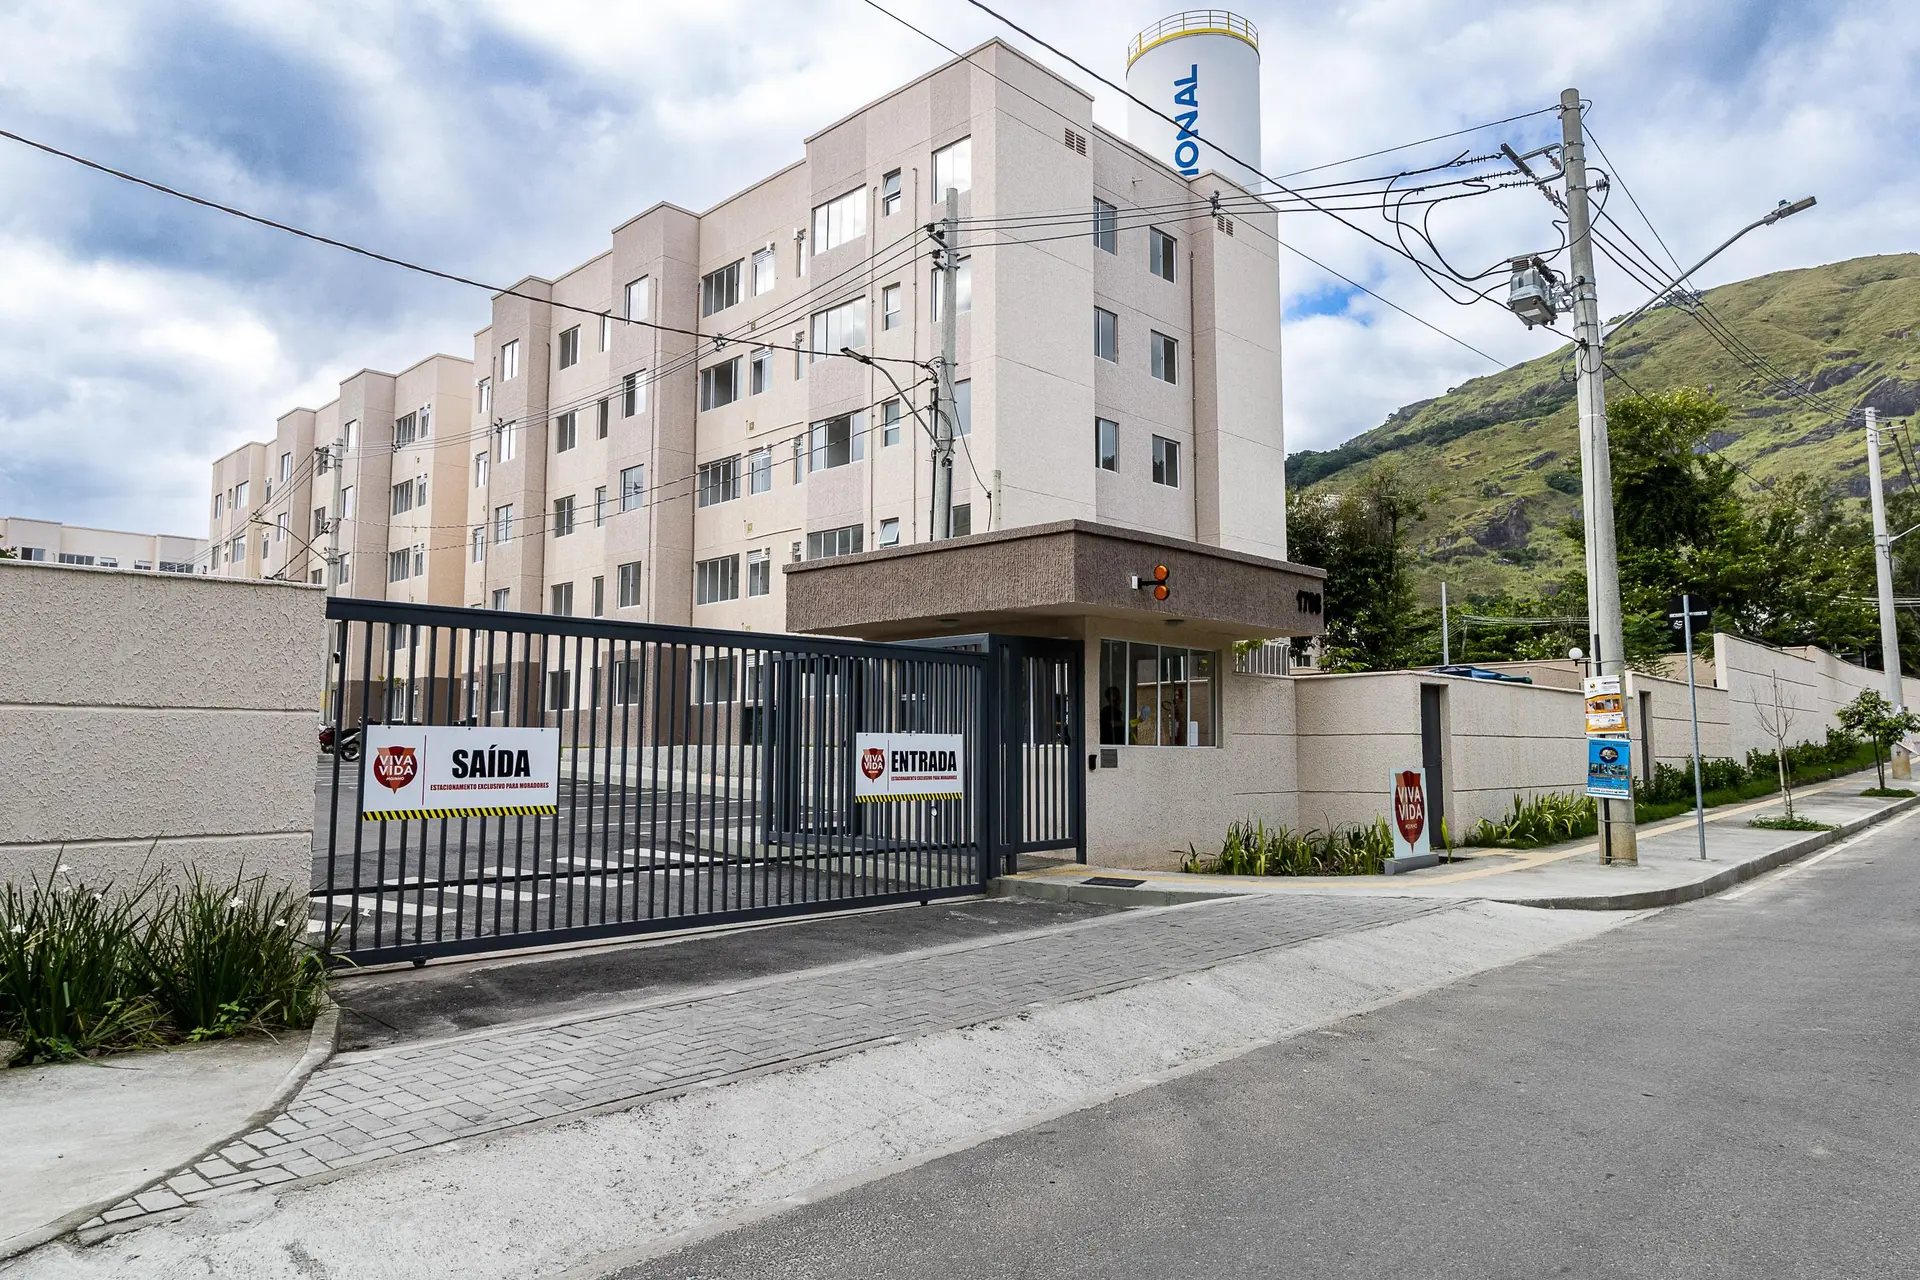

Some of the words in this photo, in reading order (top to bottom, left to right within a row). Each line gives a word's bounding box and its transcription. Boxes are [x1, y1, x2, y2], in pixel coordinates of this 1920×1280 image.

[379, 755, 413, 765] VIVA
[452, 744, 531, 779] SAÍDA
[864, 754, 883, 762] VIVA
[891, 750, 957, 772] ENTRADA
[379, 765, 414, 776] VIDA
[864, 762, 883, 770] VIDA
[430, 783, 476, 791] ESTACIONAMENTO
[1397, 786, 1421, 802] VIVA
[1398, 804, 1423, 820] VIDA
